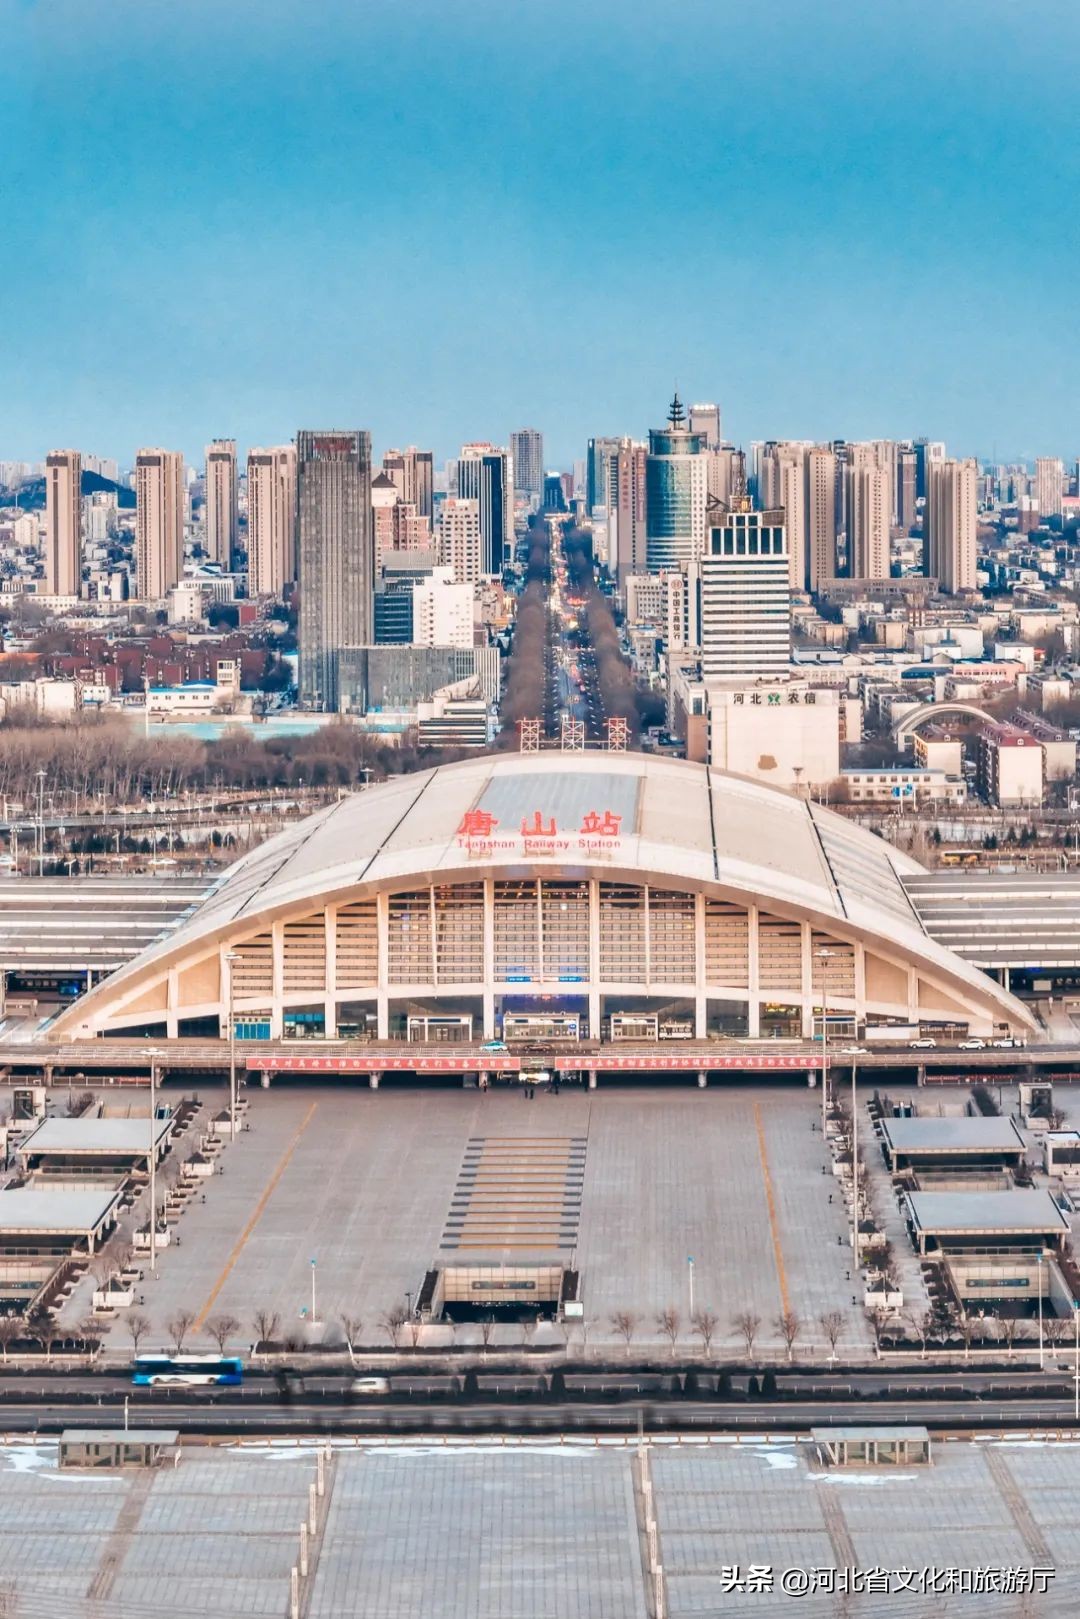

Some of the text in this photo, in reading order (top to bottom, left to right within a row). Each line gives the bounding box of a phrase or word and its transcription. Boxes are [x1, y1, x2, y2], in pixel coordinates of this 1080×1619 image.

[672, 591, 681, 640] 中国工商银行
[456, 809, 622, 836] 唐山站
[458, 838, 621, 850] Tangshan Railway Station
